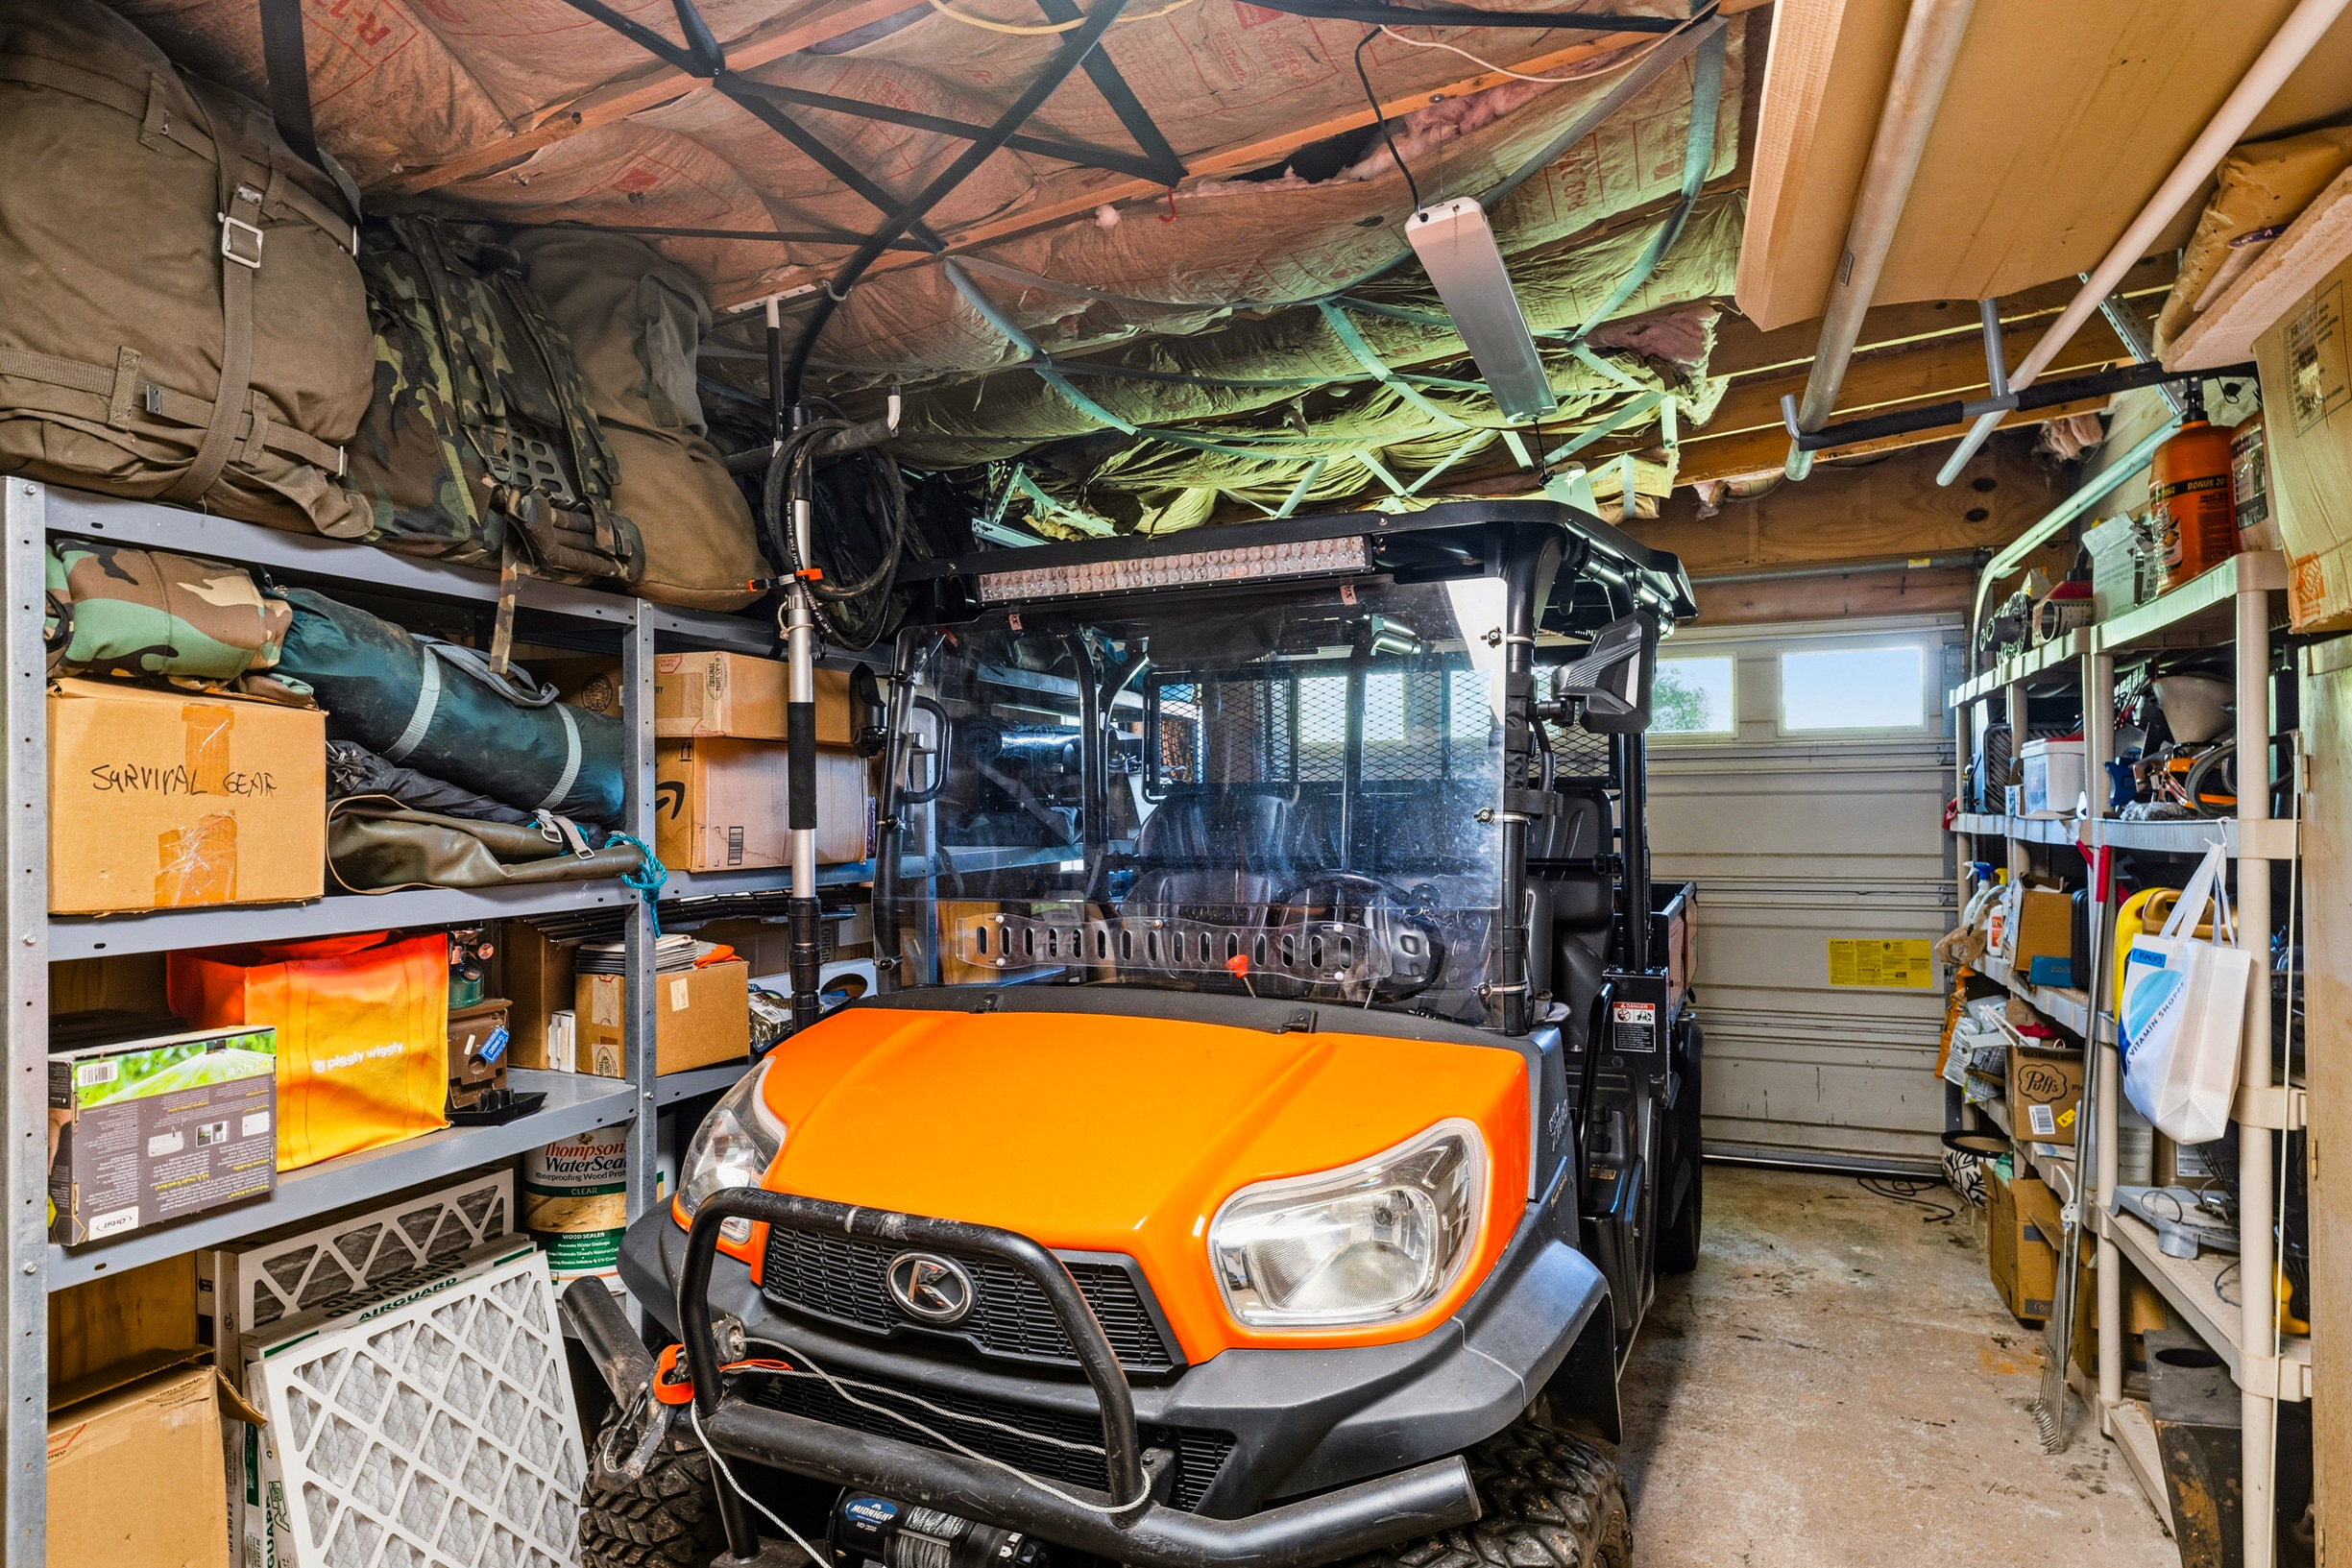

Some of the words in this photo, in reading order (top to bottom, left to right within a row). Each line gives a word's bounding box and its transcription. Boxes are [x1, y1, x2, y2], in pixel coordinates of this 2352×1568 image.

[91, 764, 207, 796] SURVIVAL
[223, 771, 278, 799] GEAR
[2129, 1018, 2158, 1056] VITAMIN
[327, 1050, 364, 1071] piggly
[366, 1041, 403, 1059] wiggly
[2025, 1071, 2059, 1095] Puffs
[545, 1140, 626, 1160] Thompson'
[546, 1156, 626, 1172] WaterSea
[583, 1171, 607, 1180] Wood
[571, 1187, 597, 1196] CLEAR
[103, 1218, 127, 1229] Orbit
[322, 1254, 461, 1308] AIRGUARD
[325, 1263, 468, 1318] AIRGUARD
[358, 1277, 457, 1322] AIRGUARD
